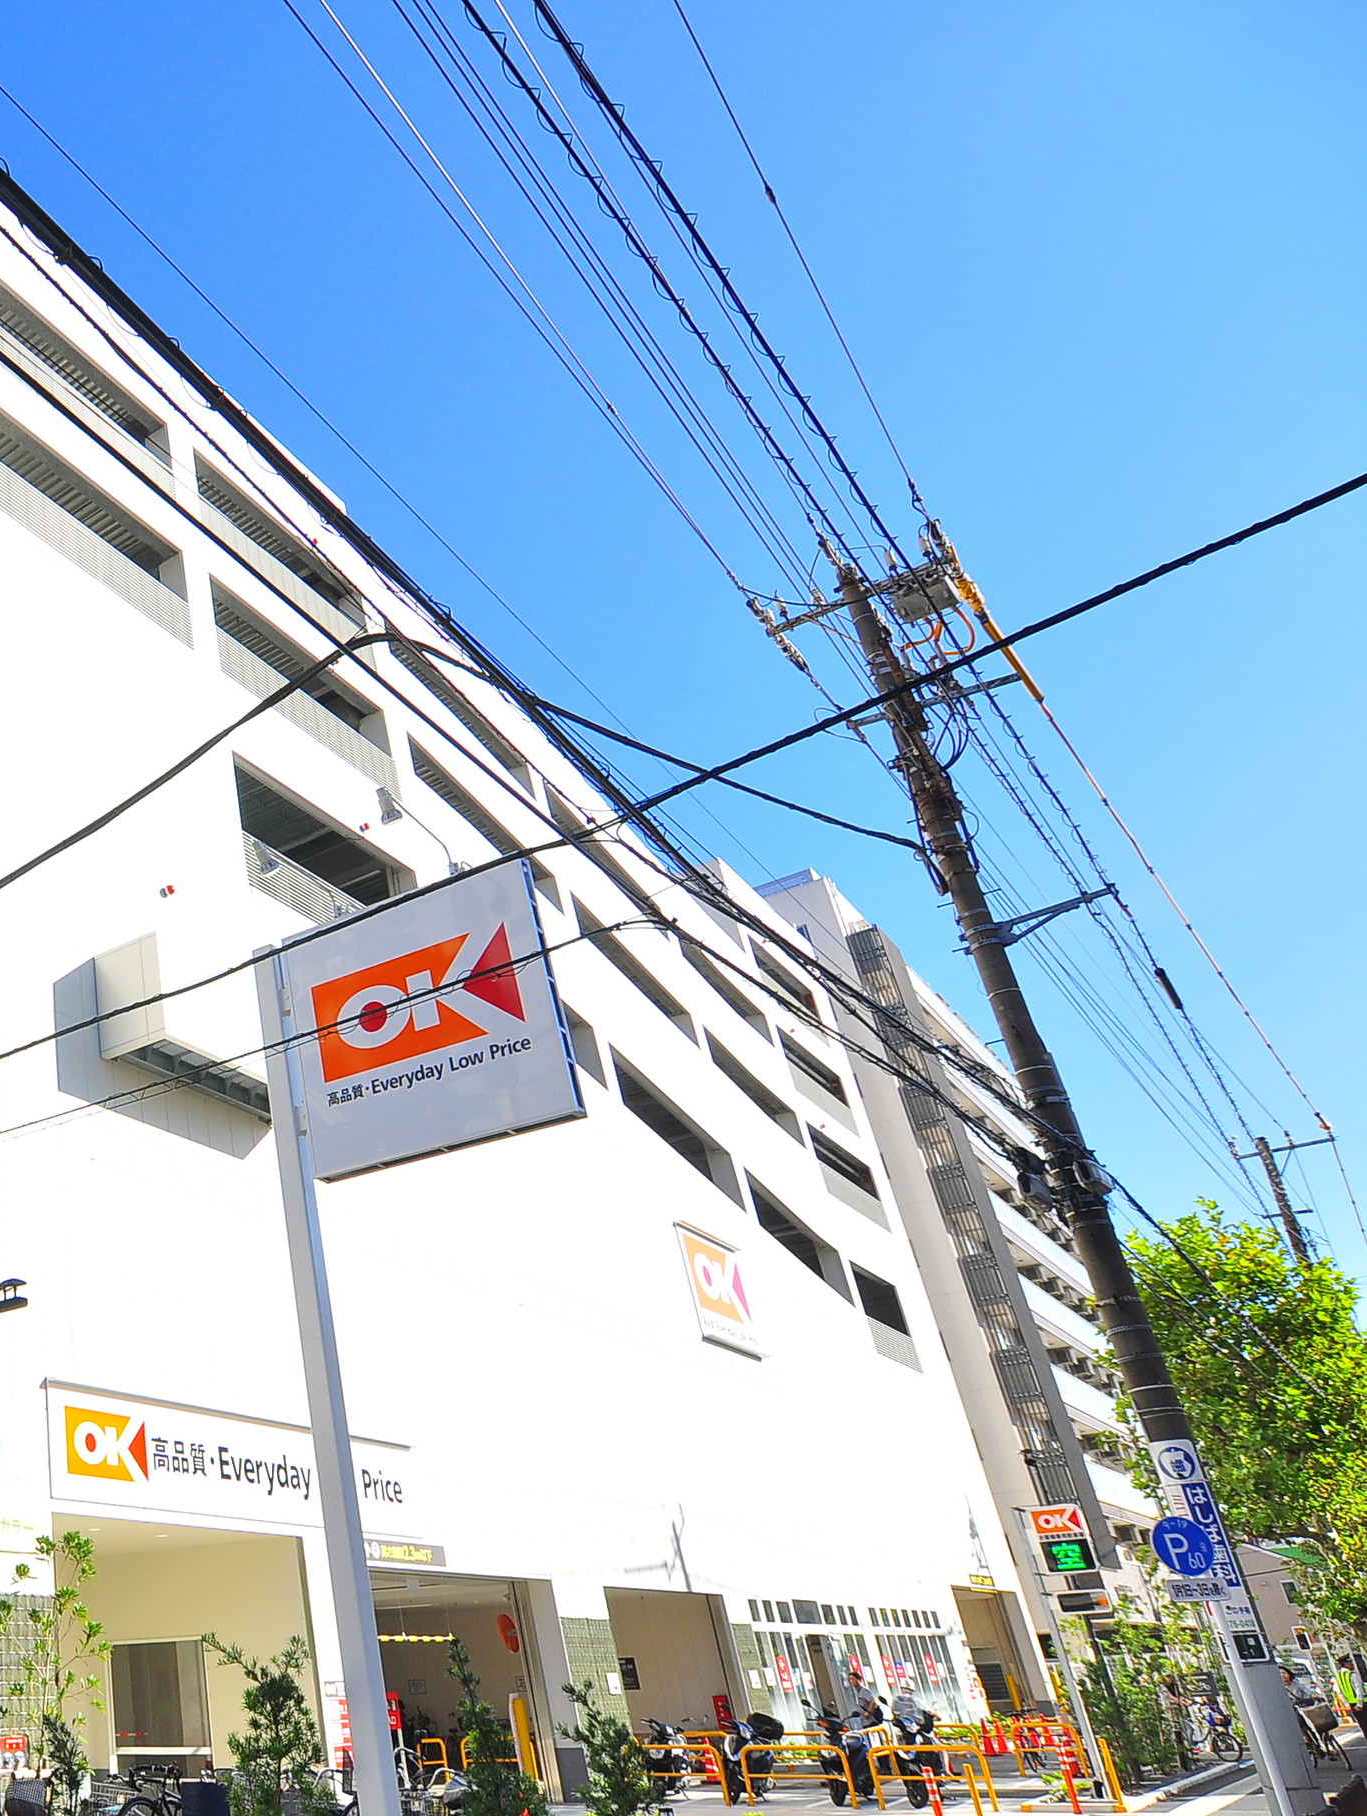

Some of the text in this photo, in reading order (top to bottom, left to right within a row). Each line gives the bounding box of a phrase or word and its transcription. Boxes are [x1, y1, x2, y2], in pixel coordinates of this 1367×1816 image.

[335, 923, 526, 1050] OK
[448, 1050, 484, 1072] Low
[489, 1037, 532, 1060] Price
[73, 1411, 148, 1481] OK
[361, 1468, 403, 1503] Price
